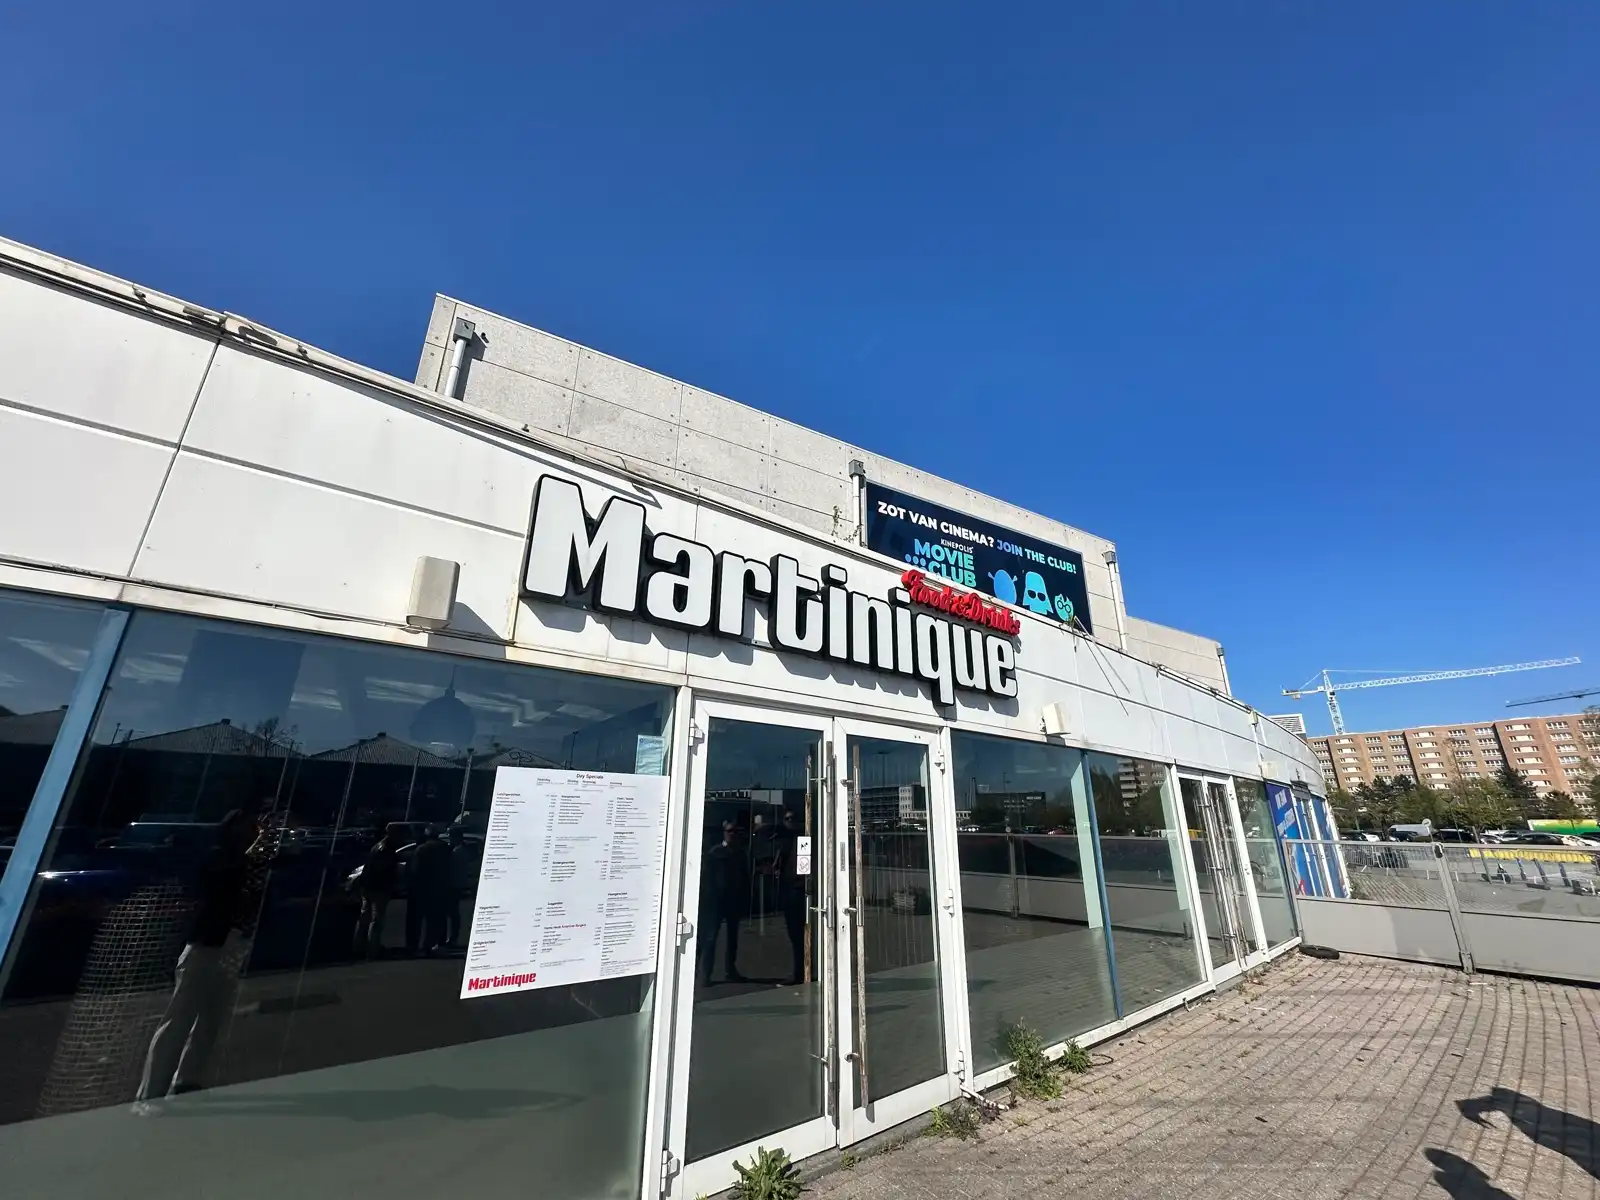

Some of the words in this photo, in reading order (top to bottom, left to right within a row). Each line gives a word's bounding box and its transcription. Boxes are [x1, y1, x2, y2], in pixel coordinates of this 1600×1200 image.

[877, 501, 906, 520] ZOT
[908, 510, 938, 530] VAN
[940, 521, 995, 548] CINEMA?
[996, 539, 1023, 557] JOIN
[1024, 548, 1046, 564] THE
[1047, 556, 1077, 574] CLUB!
[940, 538, 973, 554] KINEPOLIS
[914, 538, 975, 571] MOVIE
[928, 560, 977, 588] CLUB
[519, 473, 1018, 706] Martinique
[468, 972, 537, 991] Martinique
